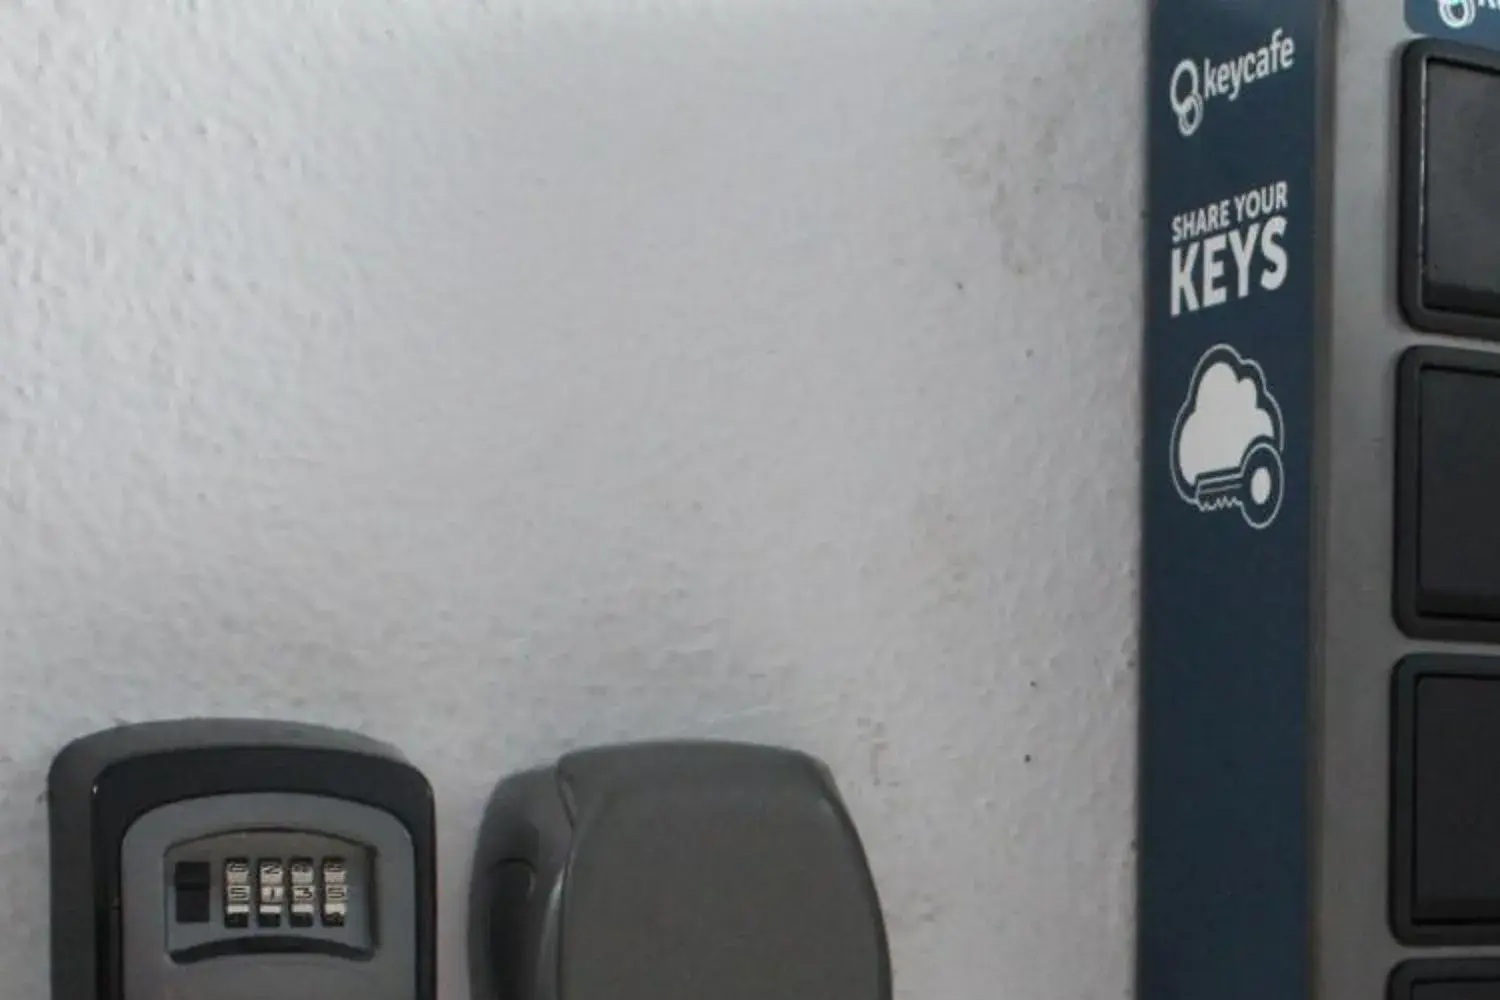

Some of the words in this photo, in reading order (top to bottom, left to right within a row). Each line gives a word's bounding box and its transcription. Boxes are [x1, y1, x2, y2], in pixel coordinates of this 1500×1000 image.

[1202, 28, 1295, 101] keycafe
[1172, 199, 1230, 245] SHARE
[1234, 181, 1288, 225] YOUR
[1170, 216, 1288, 315] KEYS
